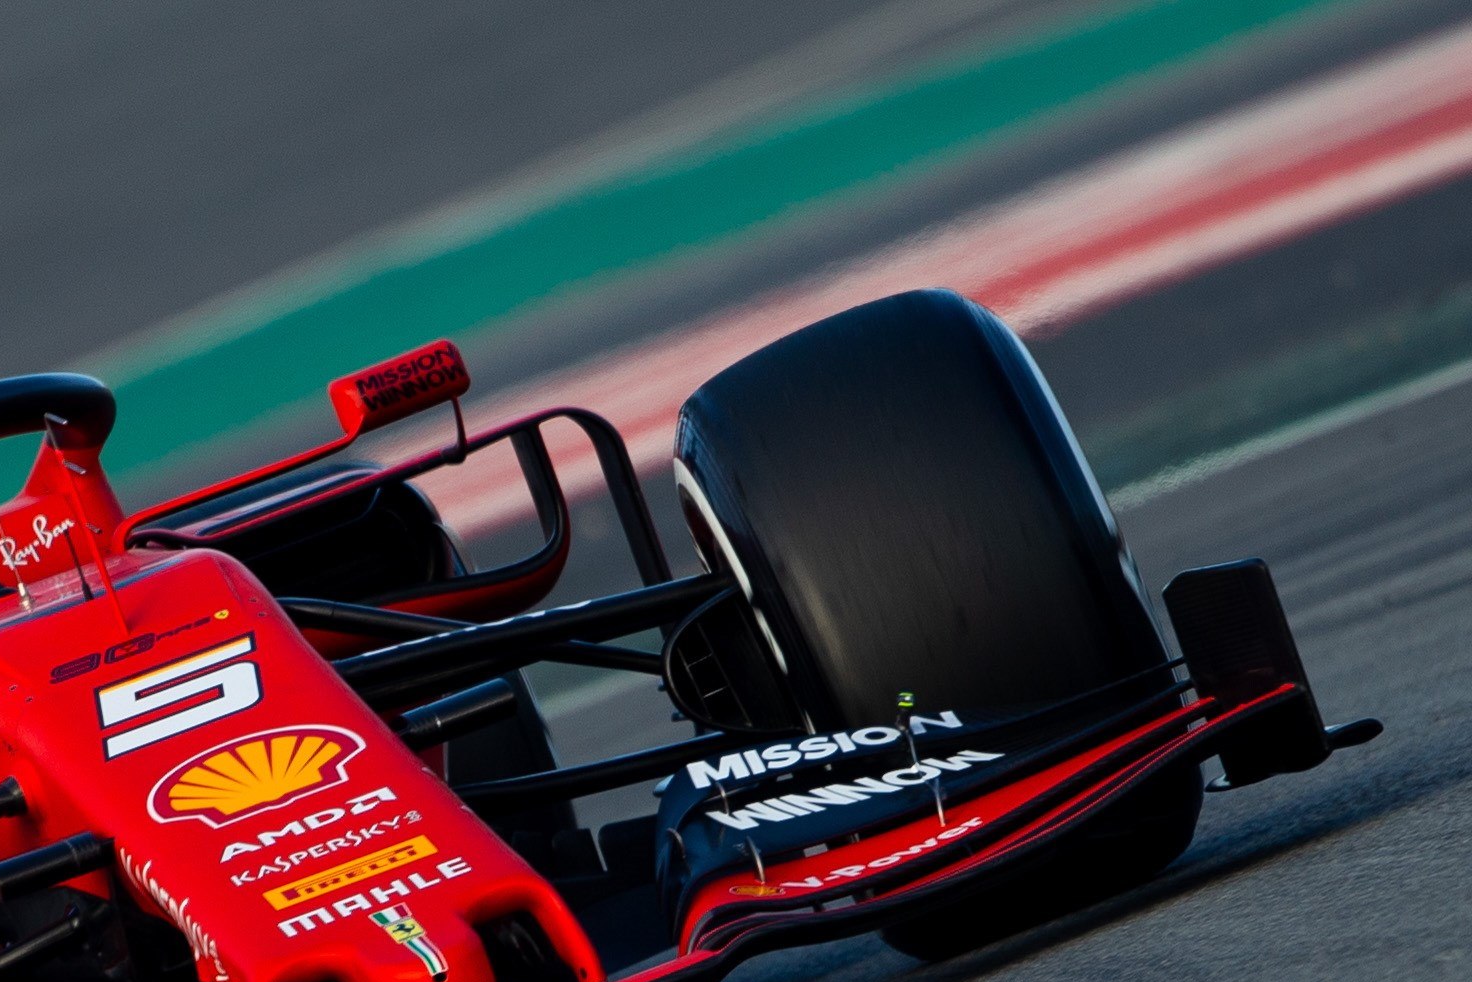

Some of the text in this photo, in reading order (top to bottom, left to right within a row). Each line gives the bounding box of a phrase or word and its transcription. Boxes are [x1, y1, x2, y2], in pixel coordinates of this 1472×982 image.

[355, 343, 459, 395] MISSION
[362, 364, 466, 411] WINNOW
[93, 631, 264, 762] 5
[686, 710, 964, 789] MISSION
[705, 750, 1006, 830] WINNOW
[229, 814, 401, 888] KASPERSKY
[280, 844, 417, 902] PIRELLI
[779, 816, 983, 889] V-Power
[276, 856, 473, 939] MAHLE
